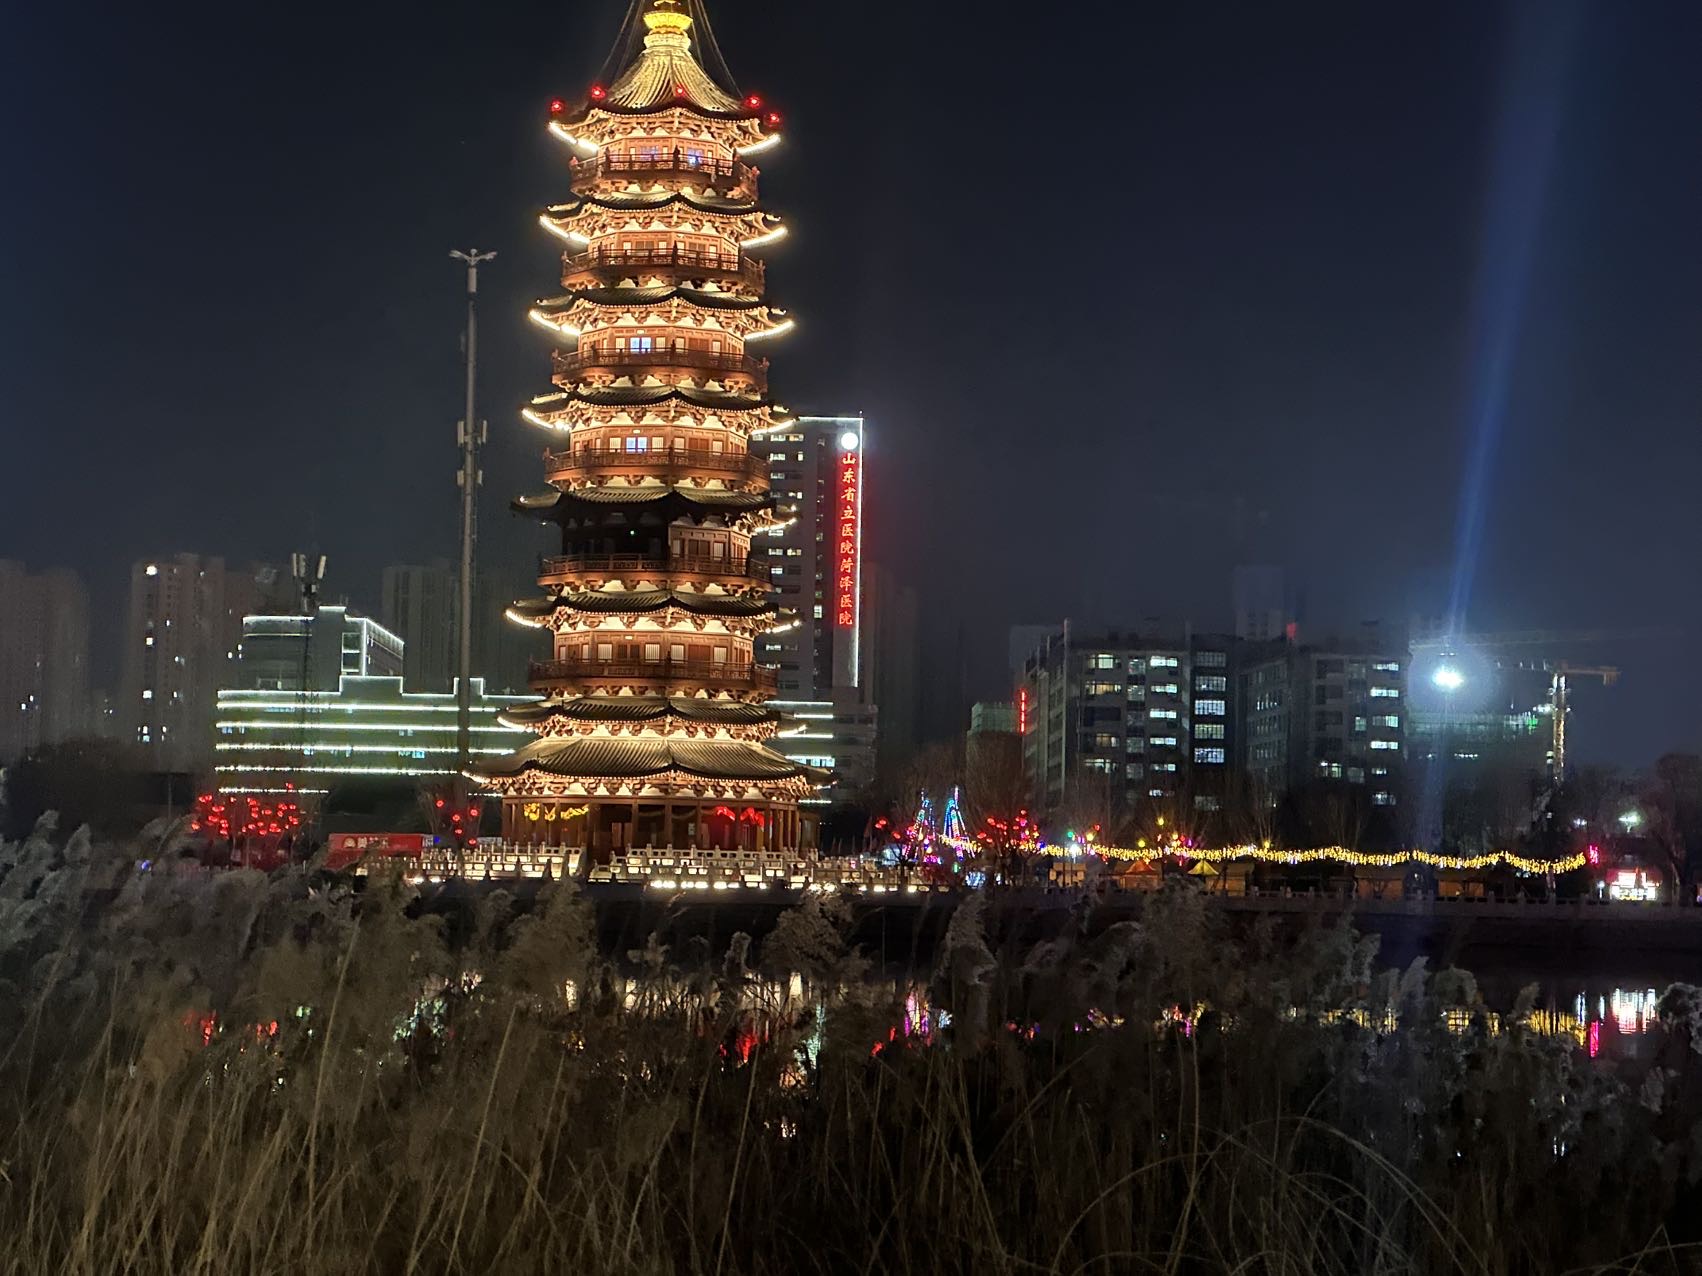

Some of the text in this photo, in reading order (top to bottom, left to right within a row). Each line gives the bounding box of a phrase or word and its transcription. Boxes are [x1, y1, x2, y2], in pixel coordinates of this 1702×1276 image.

[838, 452, 857, 625] 山东省立医院菏泽医院
